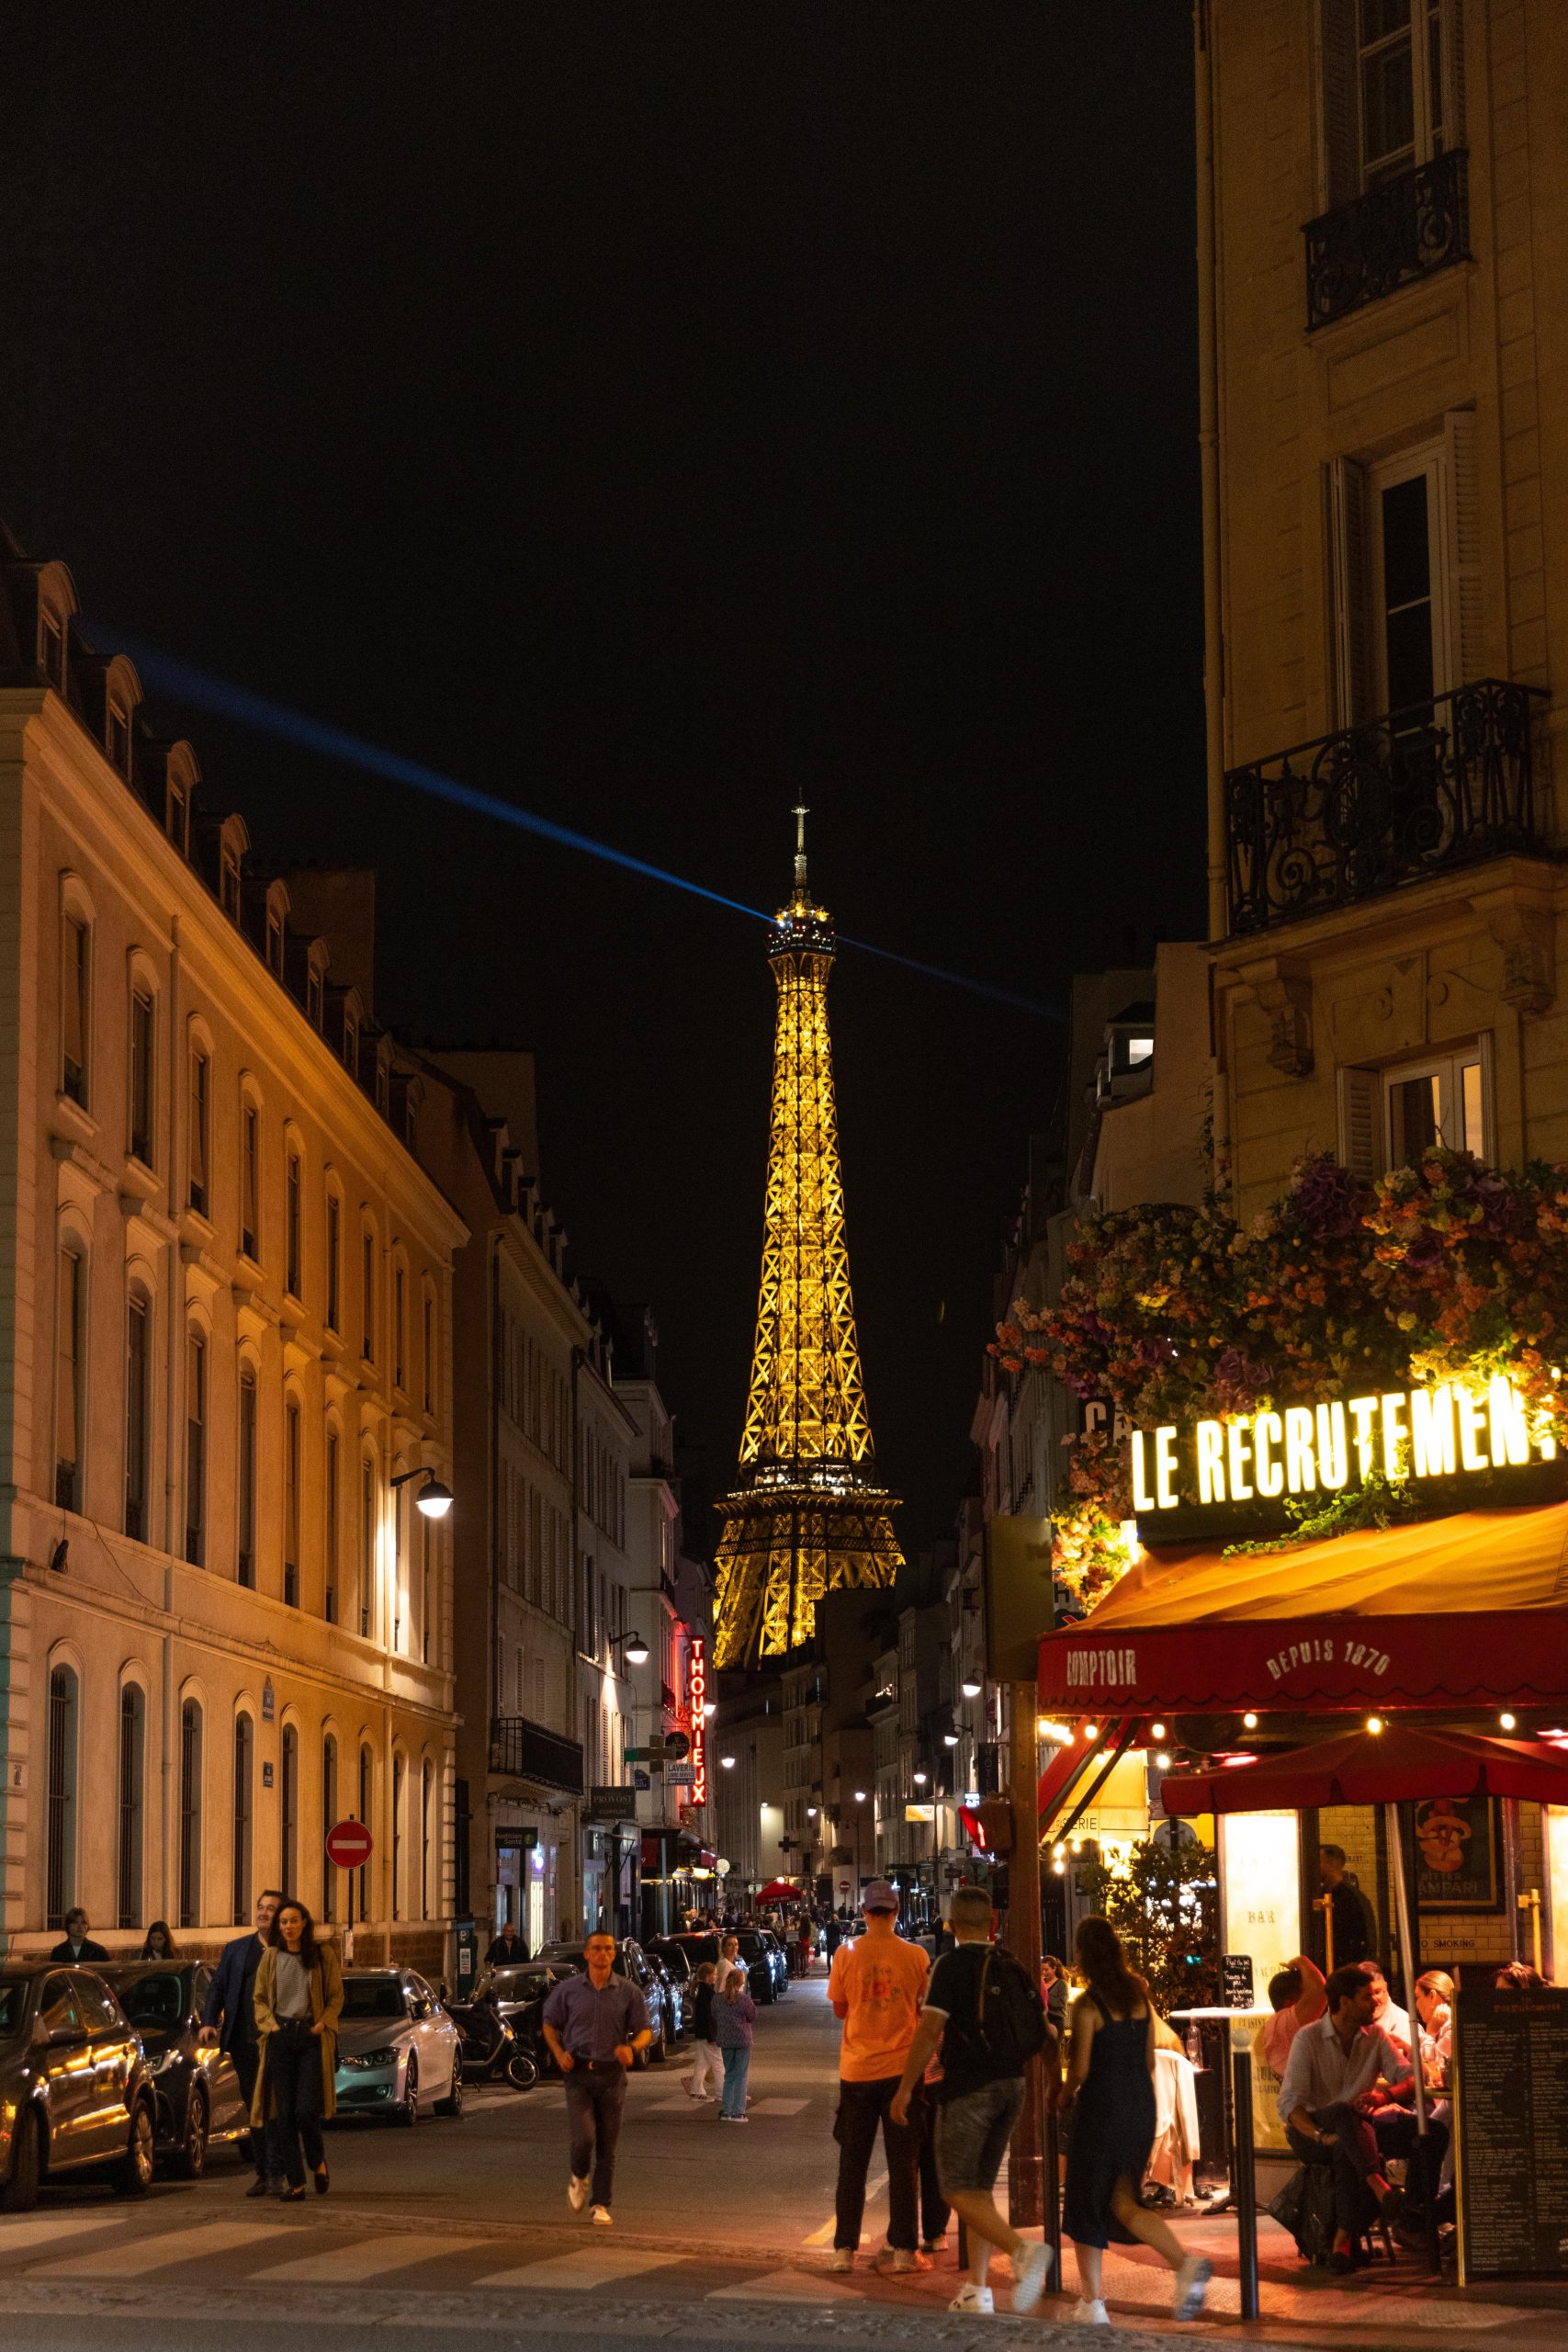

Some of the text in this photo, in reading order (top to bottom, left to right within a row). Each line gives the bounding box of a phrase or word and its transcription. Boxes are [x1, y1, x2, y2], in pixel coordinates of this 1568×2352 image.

[1131, 1376, 1556, 1511] LE RECRUTEMEN
[1266, 1639, 1391, 1680] DEPUIS 1870
[1066, 1648, 1137, 1687] COMPTOIR
[691, 1639, 705, 1804] THOUMIEUX
[668, 1764, 695, 1772] LAVERIE
[593, 1794, 633, 1803] PROVOST
[1418, 1882, 1477, 1894] AMPARI
[1247, 1911, 1275, 1924] BAR
[1433, 1939, 1475, 1948] SMOKING
[1238, 2017, 1266, 2030] CUISIN
[1254, 2084, 1280, 2095] MARQ
